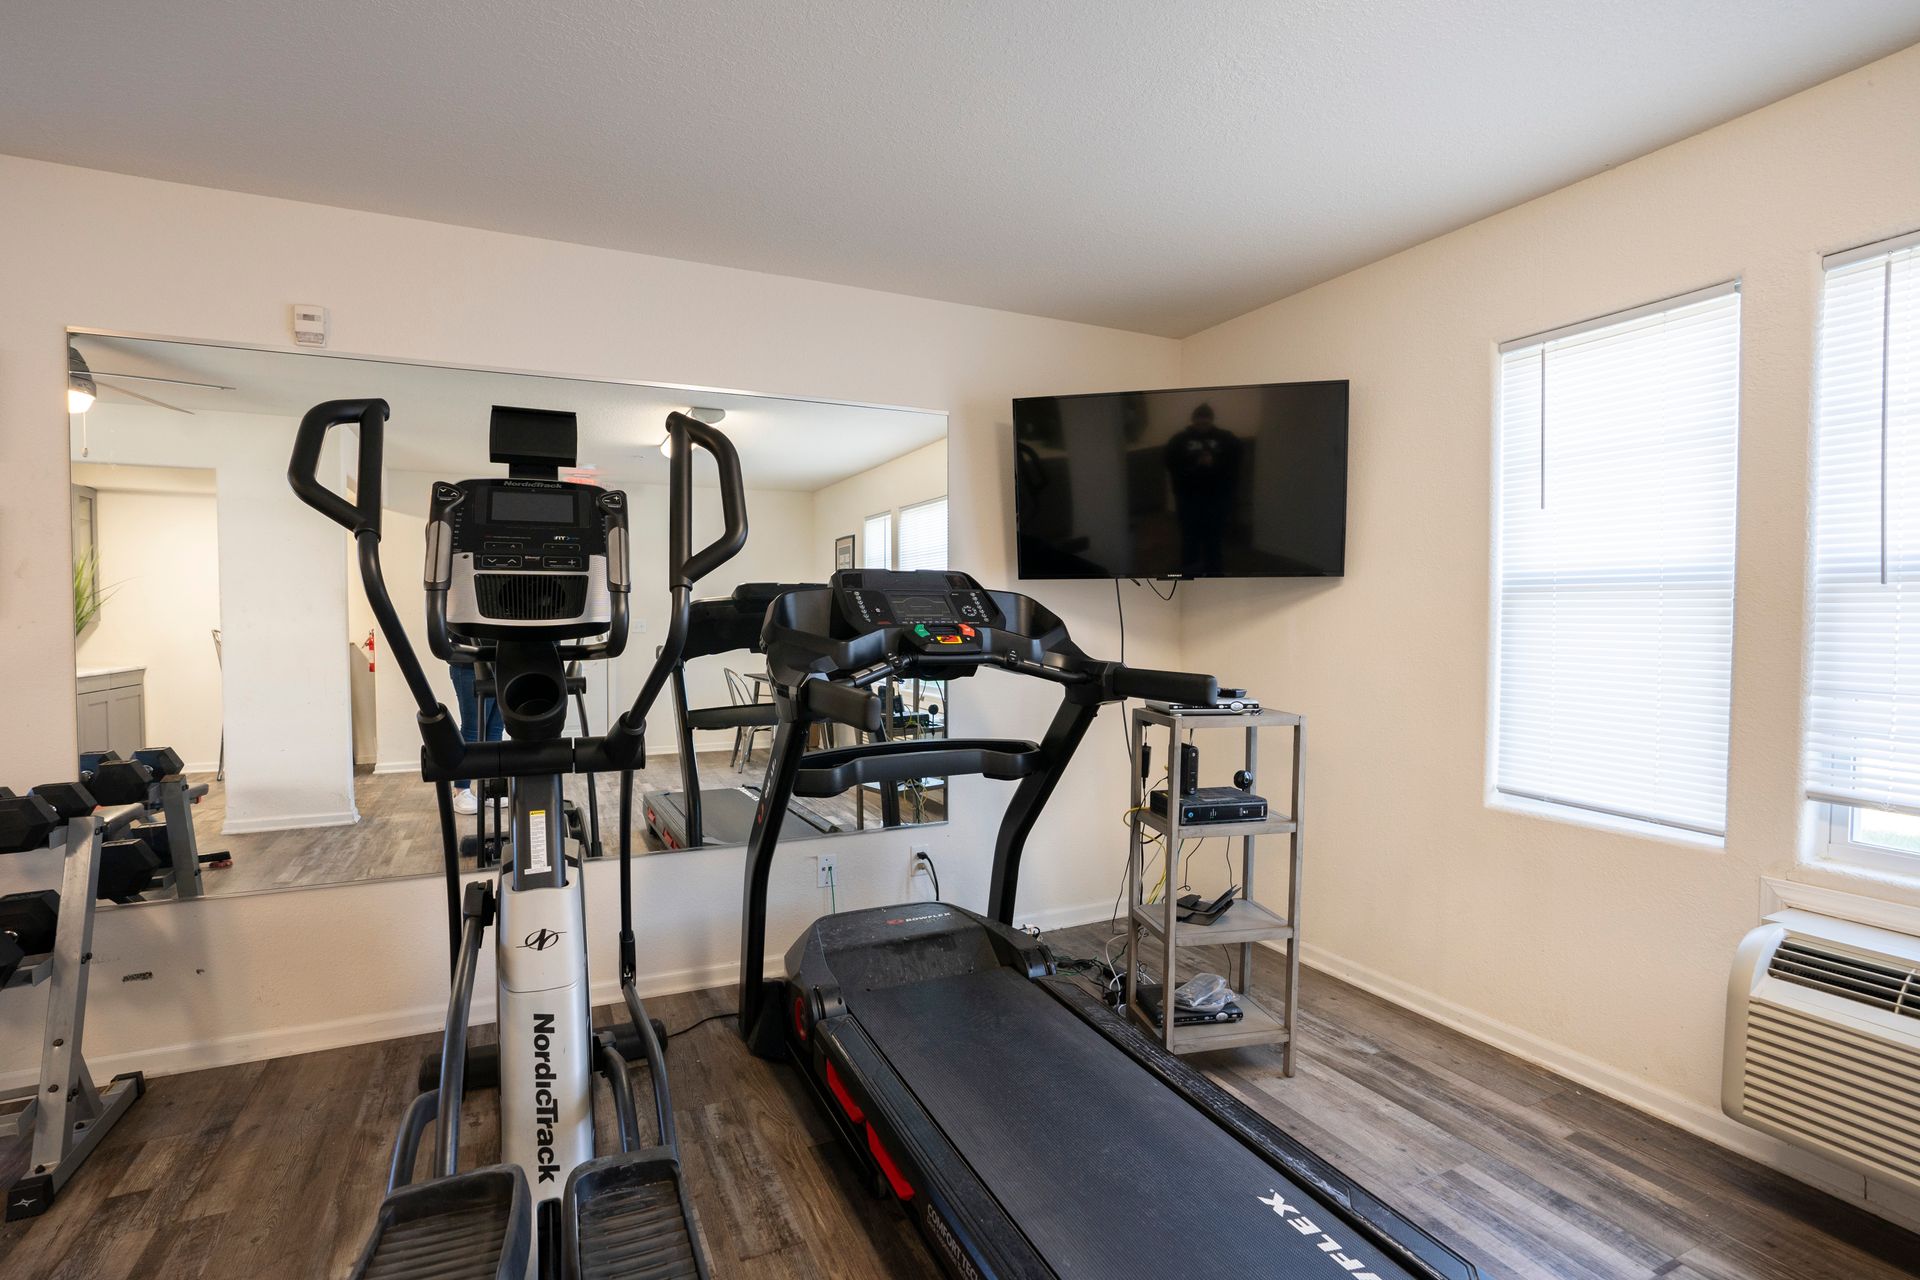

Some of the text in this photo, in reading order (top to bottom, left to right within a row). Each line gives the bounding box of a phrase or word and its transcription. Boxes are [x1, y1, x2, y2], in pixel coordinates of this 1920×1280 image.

[503, 480, 562, 489] NordicTrack
[533, 1013, 561, 1185] NordicTrack
[961, 1252, 978, 1280] TEC
